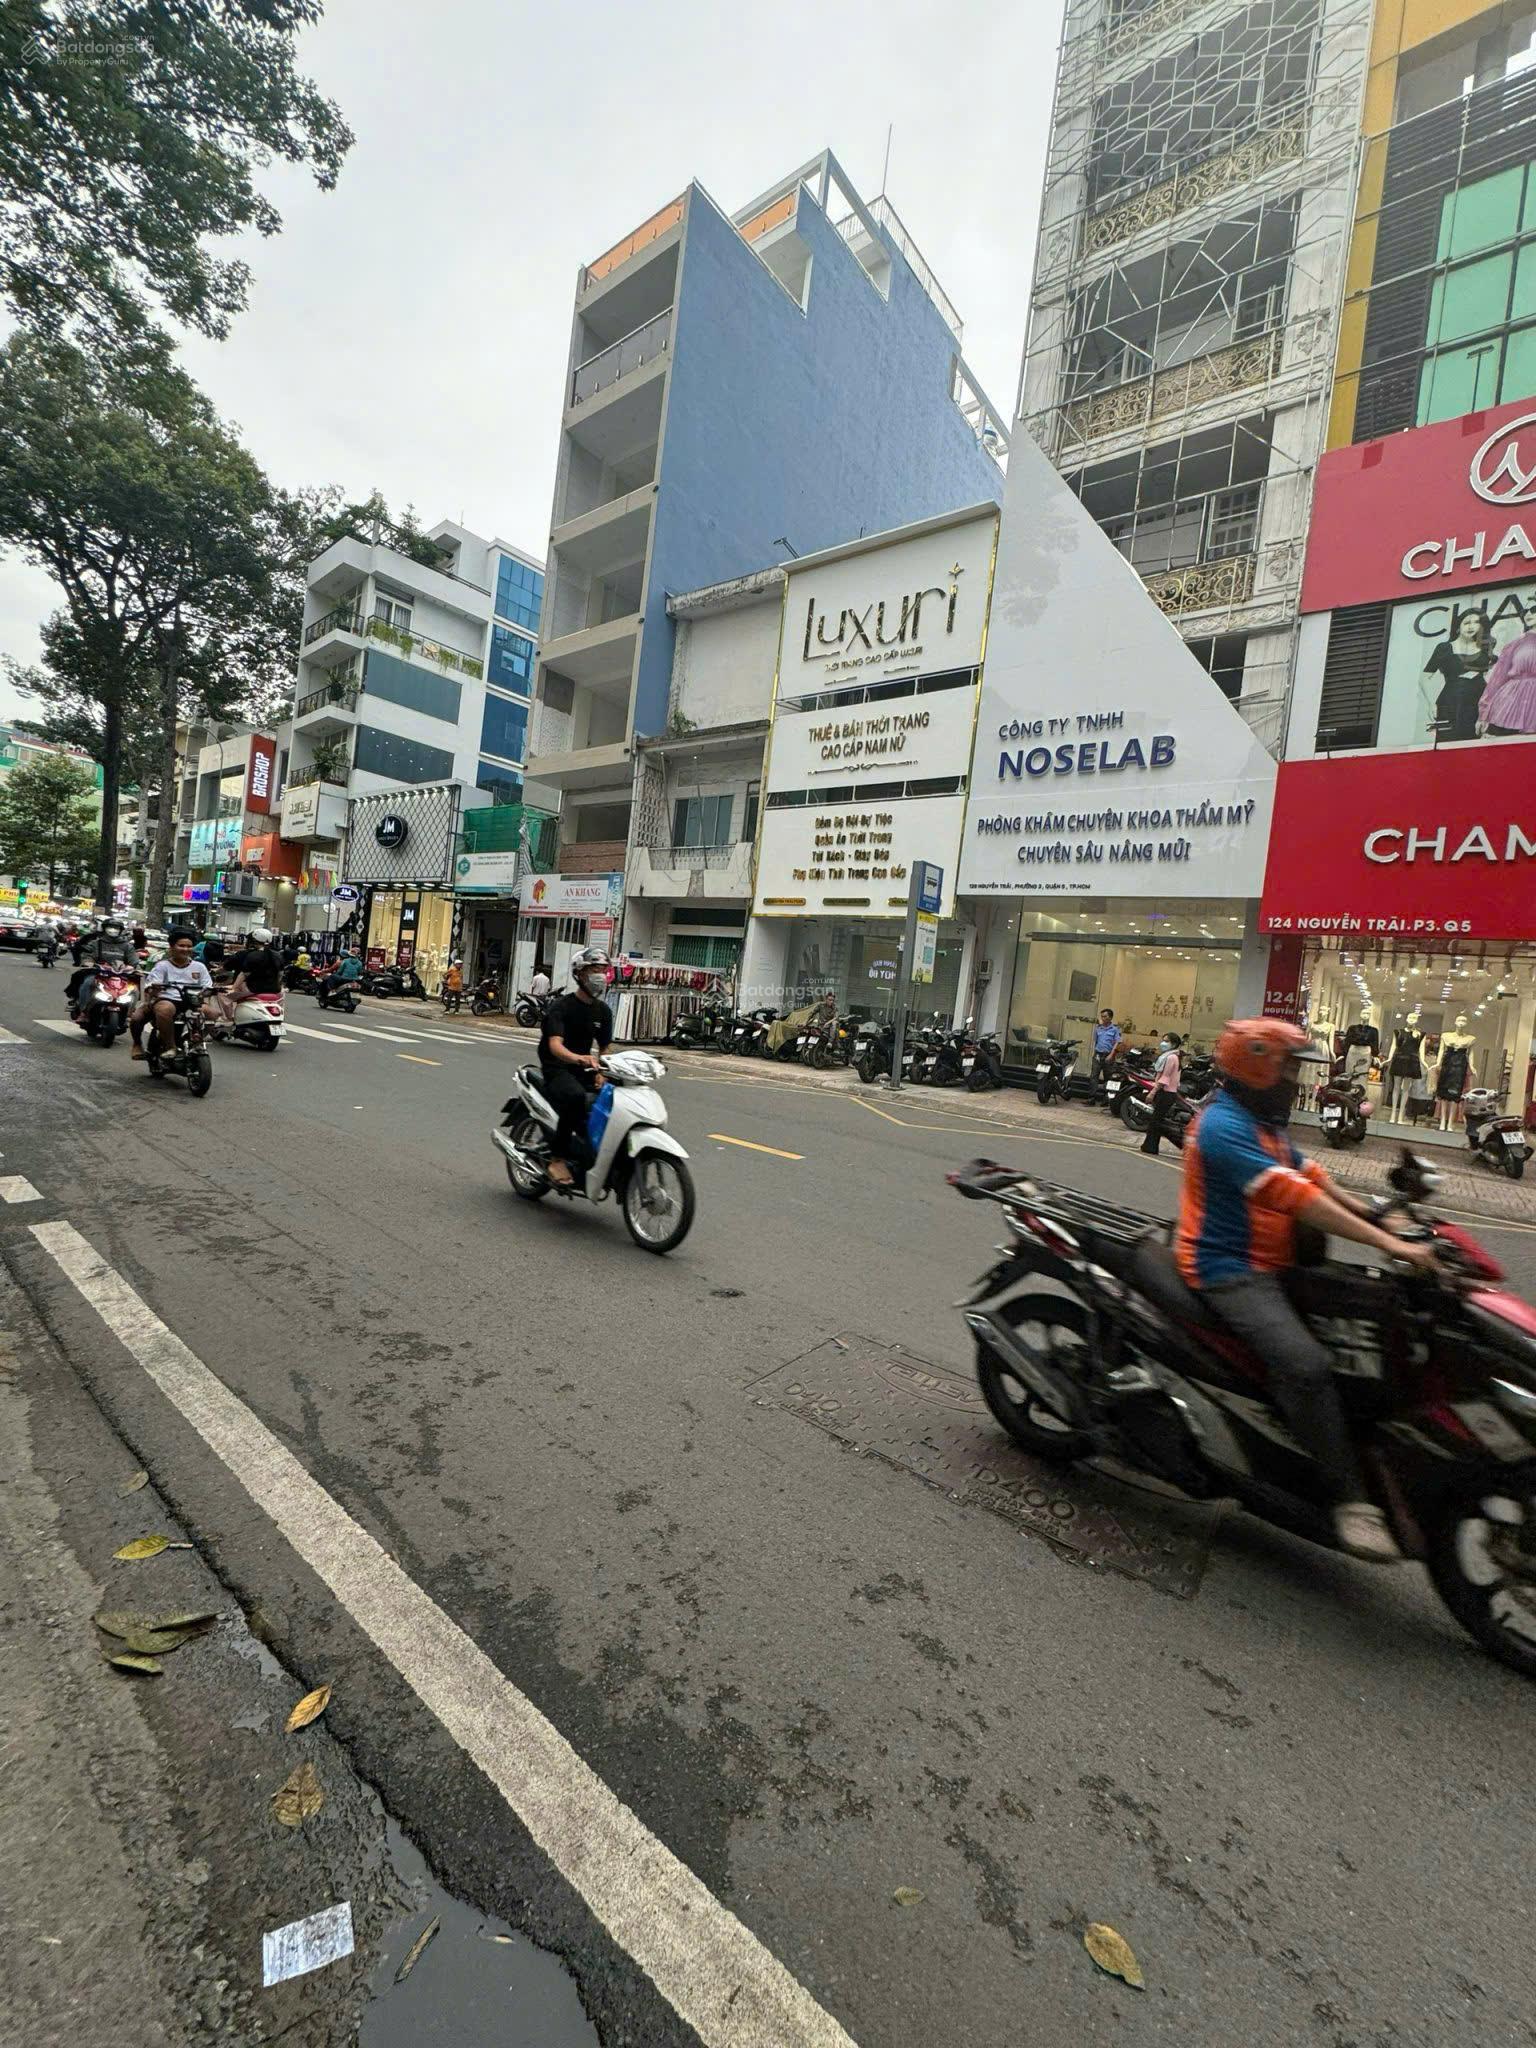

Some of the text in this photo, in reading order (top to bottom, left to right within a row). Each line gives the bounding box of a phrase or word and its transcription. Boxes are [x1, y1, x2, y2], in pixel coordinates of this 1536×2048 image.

[809, 723, 832, 742] THUÊ
[833, 724, 840, 739] &
[842, 719, 863, 739] BÁN
[893, 711, 930, 732] TRANG
[998, 711, 1124, 741] CÔNG TY TNHH
[821, 744, 840, 760] CAO
[865, 738, 887, 756] NAM
[998, 735, 1177, 781] NOSELAB
[252, 751, 271, 798] BROSHOP
[383, 818, 395, 833] JM
[977, 814, 1021, 835] PHÒNG
[1068, 807, 1122, 831] CHUYÊN
[1127, 810, 1172, 829] KHOA
[1226, 799, 1255, 825] MỸ
[1018, 837, 1192, 863] CHUYÊN SÂU NÂNG MŨI
[575, 887, 601, 897] KHANG
[1267, 917, 1292, 929] 124
[1298, 912, 1361, 930] NGUYỄN
[1266, 991, 1295, 1004] 124
